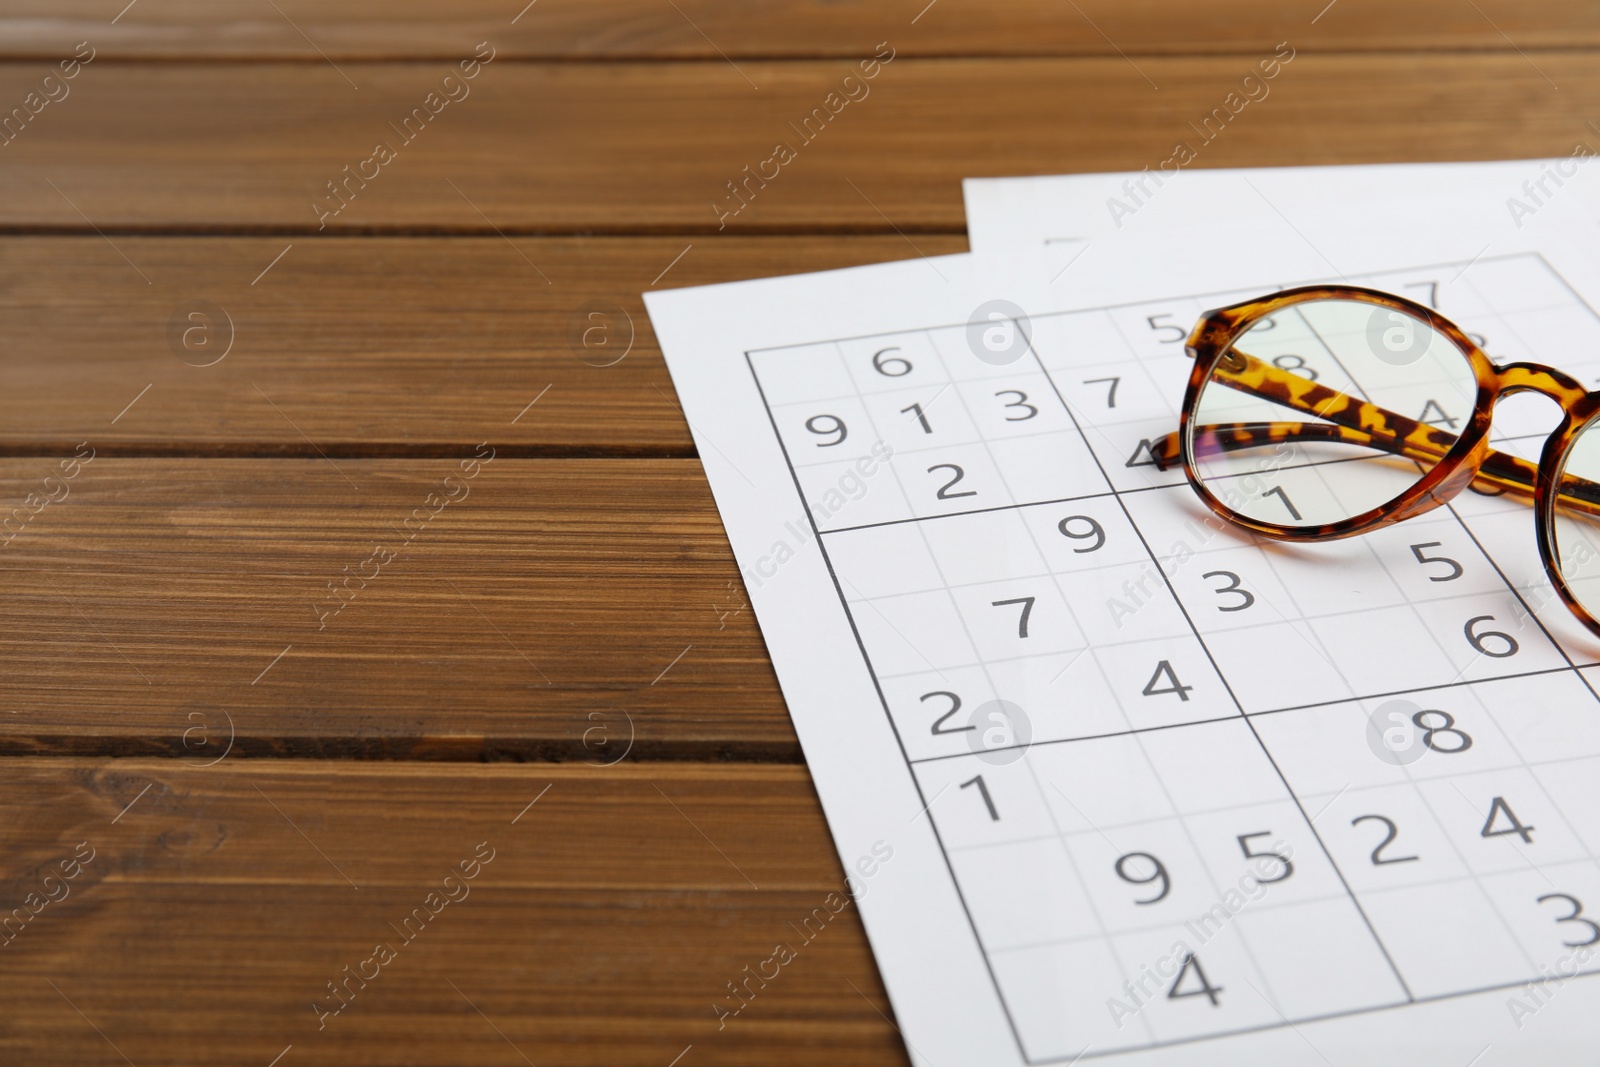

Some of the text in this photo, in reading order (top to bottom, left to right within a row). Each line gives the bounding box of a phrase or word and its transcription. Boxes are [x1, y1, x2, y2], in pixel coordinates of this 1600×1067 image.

[1403, 281, 1438, 309] 7
[1147, 314, 1188, 344] 5
[873, 346, 913, 378] 6
[995, 390, 1038, 421] 3
[1083, 377, 1120, 409] 7
[805, 414, 847, 447] 9
[901, 403, 933, 435] 1
[927, 464, 977, 500] 2
[1261, 485, 1303, 521] 1
[1058, 515, 1105, 553] 9
[1410, 542, 1463, 582] 5
[1202, 570, 1255, 612] 3
[992, 597, 1035, 638] 7
[1464, 615, 1519, 658] 6
[1142, 660, 1193, 702] 4
[920, 691, 976, 735] 2
[1412, 709, 1473, 753] 8
[959, 775, 1001, 822] 1
[1352, 815, 1419, 866] 2
[1481, 797, 1534, 844] 4
[1237, 831, 1294, 884] 5
[1114, 852, 1171, 905] 9
[1536, 893, 1600, 948] 3
[1167, 952, 1223, 1007] 4
